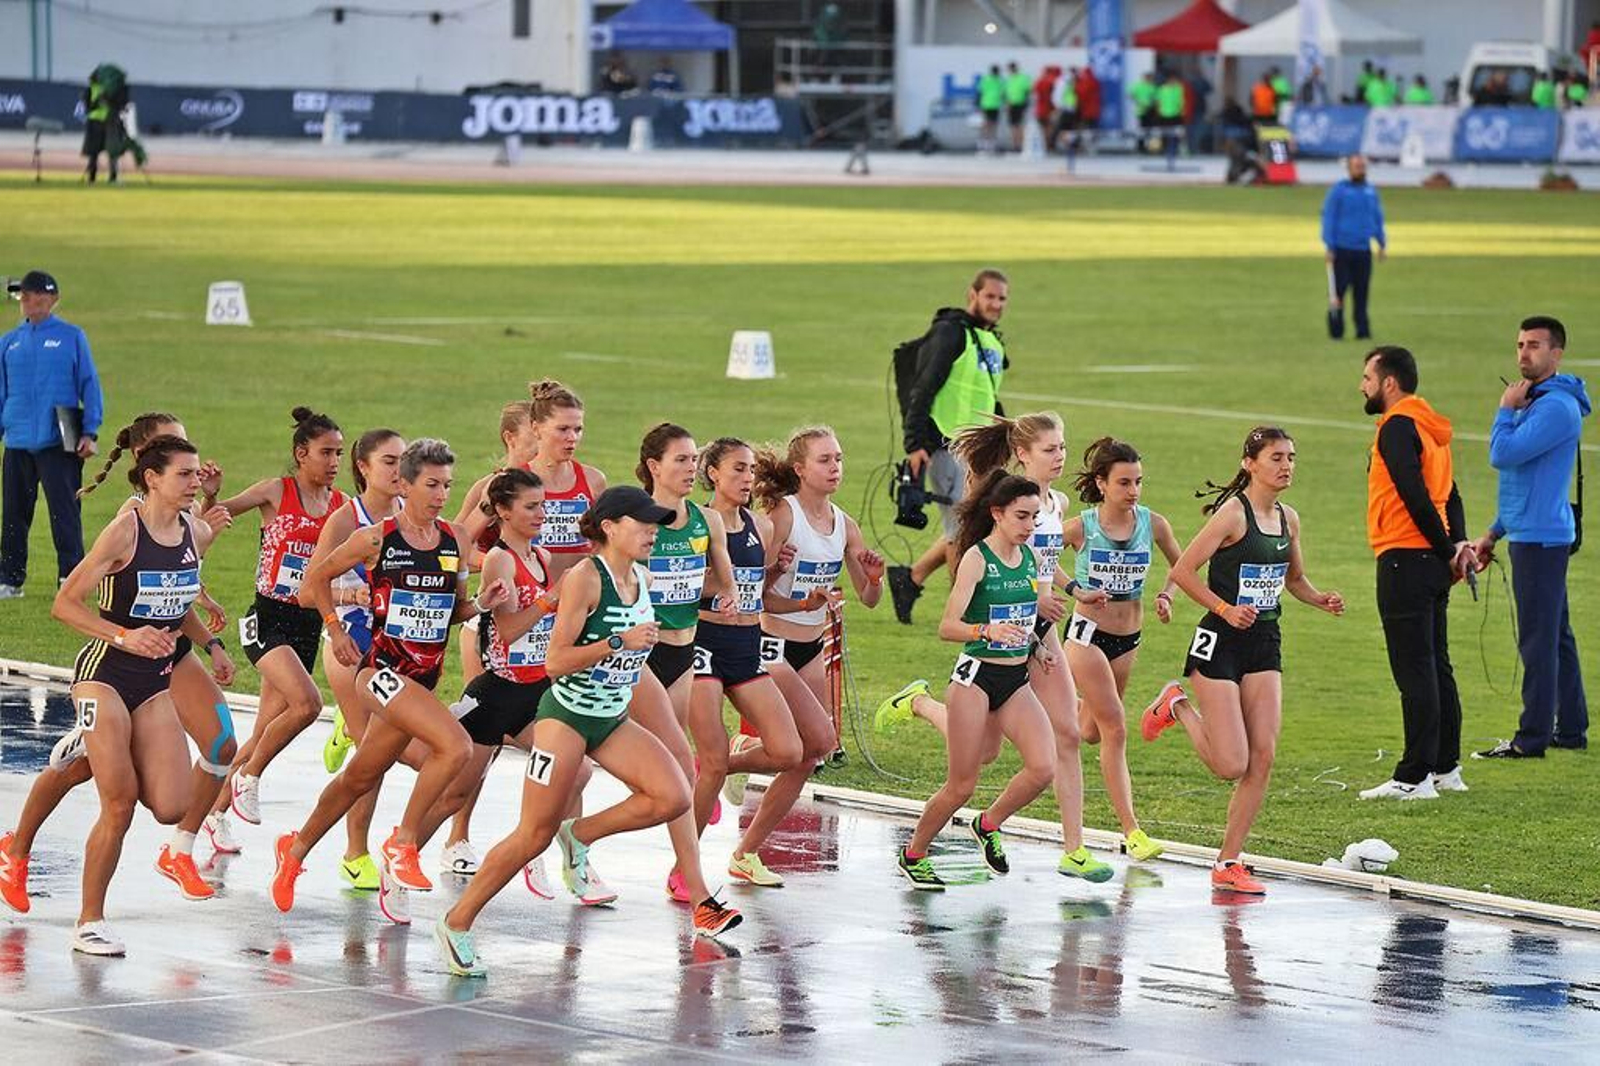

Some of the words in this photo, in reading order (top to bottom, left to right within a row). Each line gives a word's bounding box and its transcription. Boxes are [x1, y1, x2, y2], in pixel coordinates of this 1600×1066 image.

[212, 297, 240, 320] 65
[1093, 563, 1145, 573] BARBERO
[421, 575, 444, 587] BM
[399, 607, 444, 620] ROBLES
[245, 619, 257, 640] 8
[1075, 620, 1088, 640] 1
[761, 640, 779, 661] 5
[1195, 632, 1211, 656] 2
[600, 655, 645, 671] PACER
[956, 659, 974, 681] 4
[372, 671, 399, 699] 13
[530, 751, 552, 779] 17
